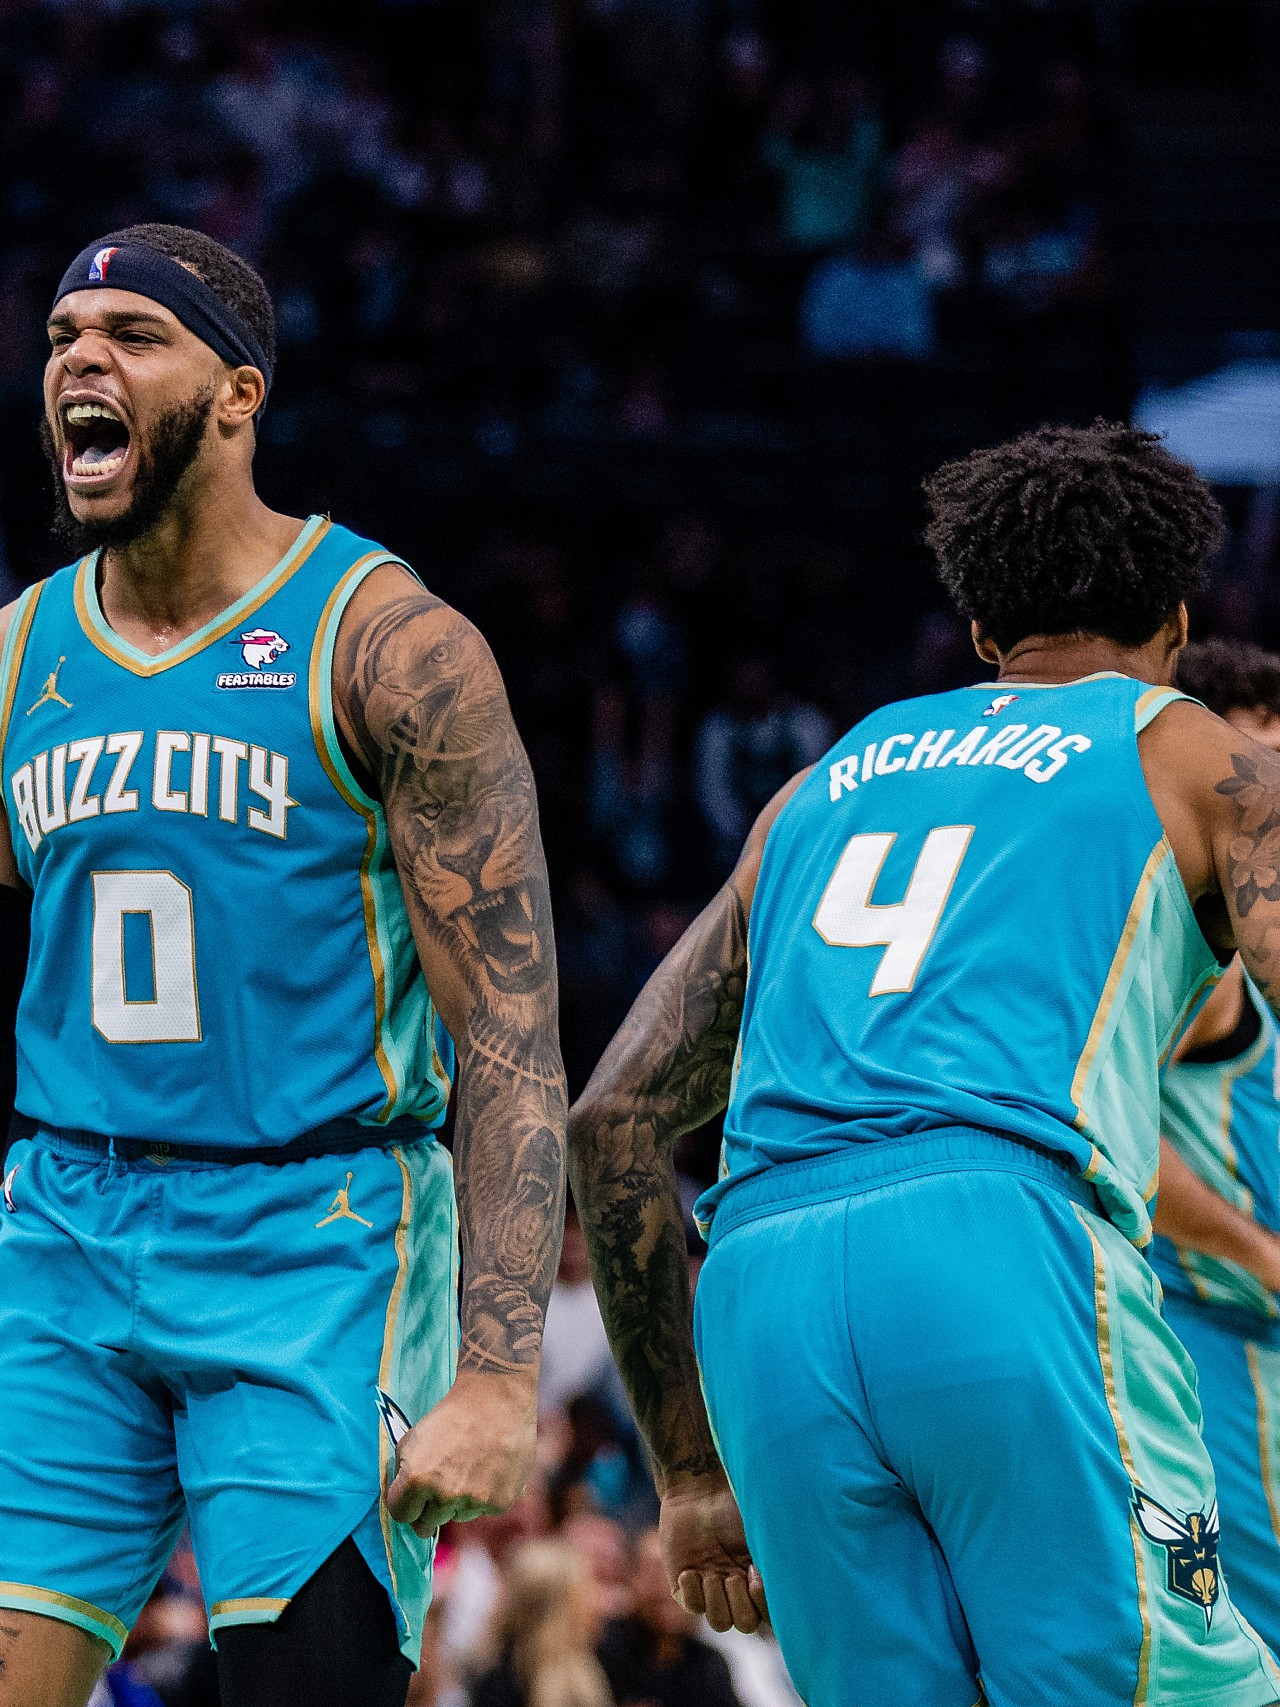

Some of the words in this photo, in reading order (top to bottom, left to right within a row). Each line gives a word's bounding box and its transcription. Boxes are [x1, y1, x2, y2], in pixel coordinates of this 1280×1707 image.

[218, 673, 295, 688] FEASTABLES
[11, 731, 144, 854] BUZZ
[152, 730, 301, 840] CITY
[829, 724, 1091, 802] RICHARDS
[90, 870, 202, 1044] 0
[812, 824, 975, 997] 4
